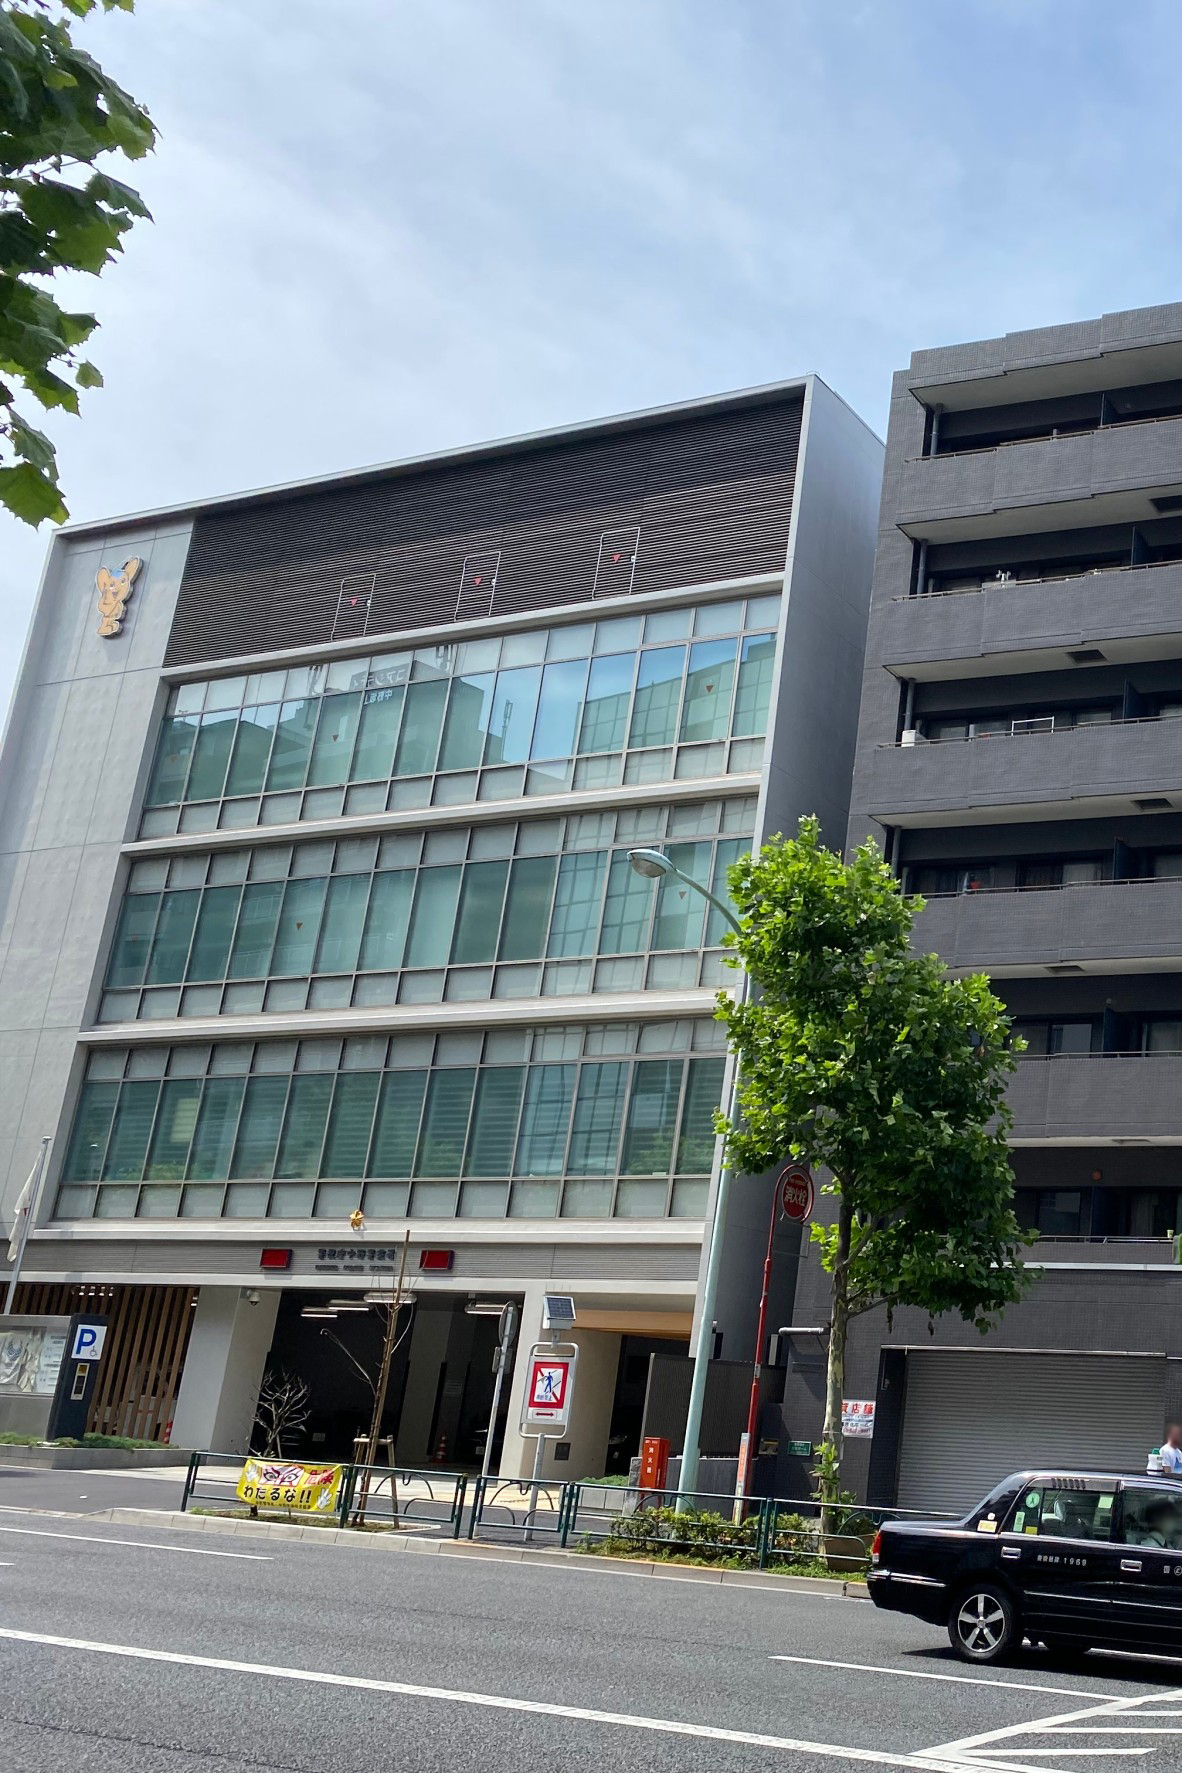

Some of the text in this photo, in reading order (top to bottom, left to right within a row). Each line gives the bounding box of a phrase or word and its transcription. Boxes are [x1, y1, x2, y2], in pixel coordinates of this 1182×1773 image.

[784, 1185, 807, 1206] 消火栓
[75, 1328, 97, 1355] P
[305, 1468, 335, 1485] 危険
[244, 1485, 313, 1504] わたるな!!
[1063, 1557, 1087, 1567] 1969
